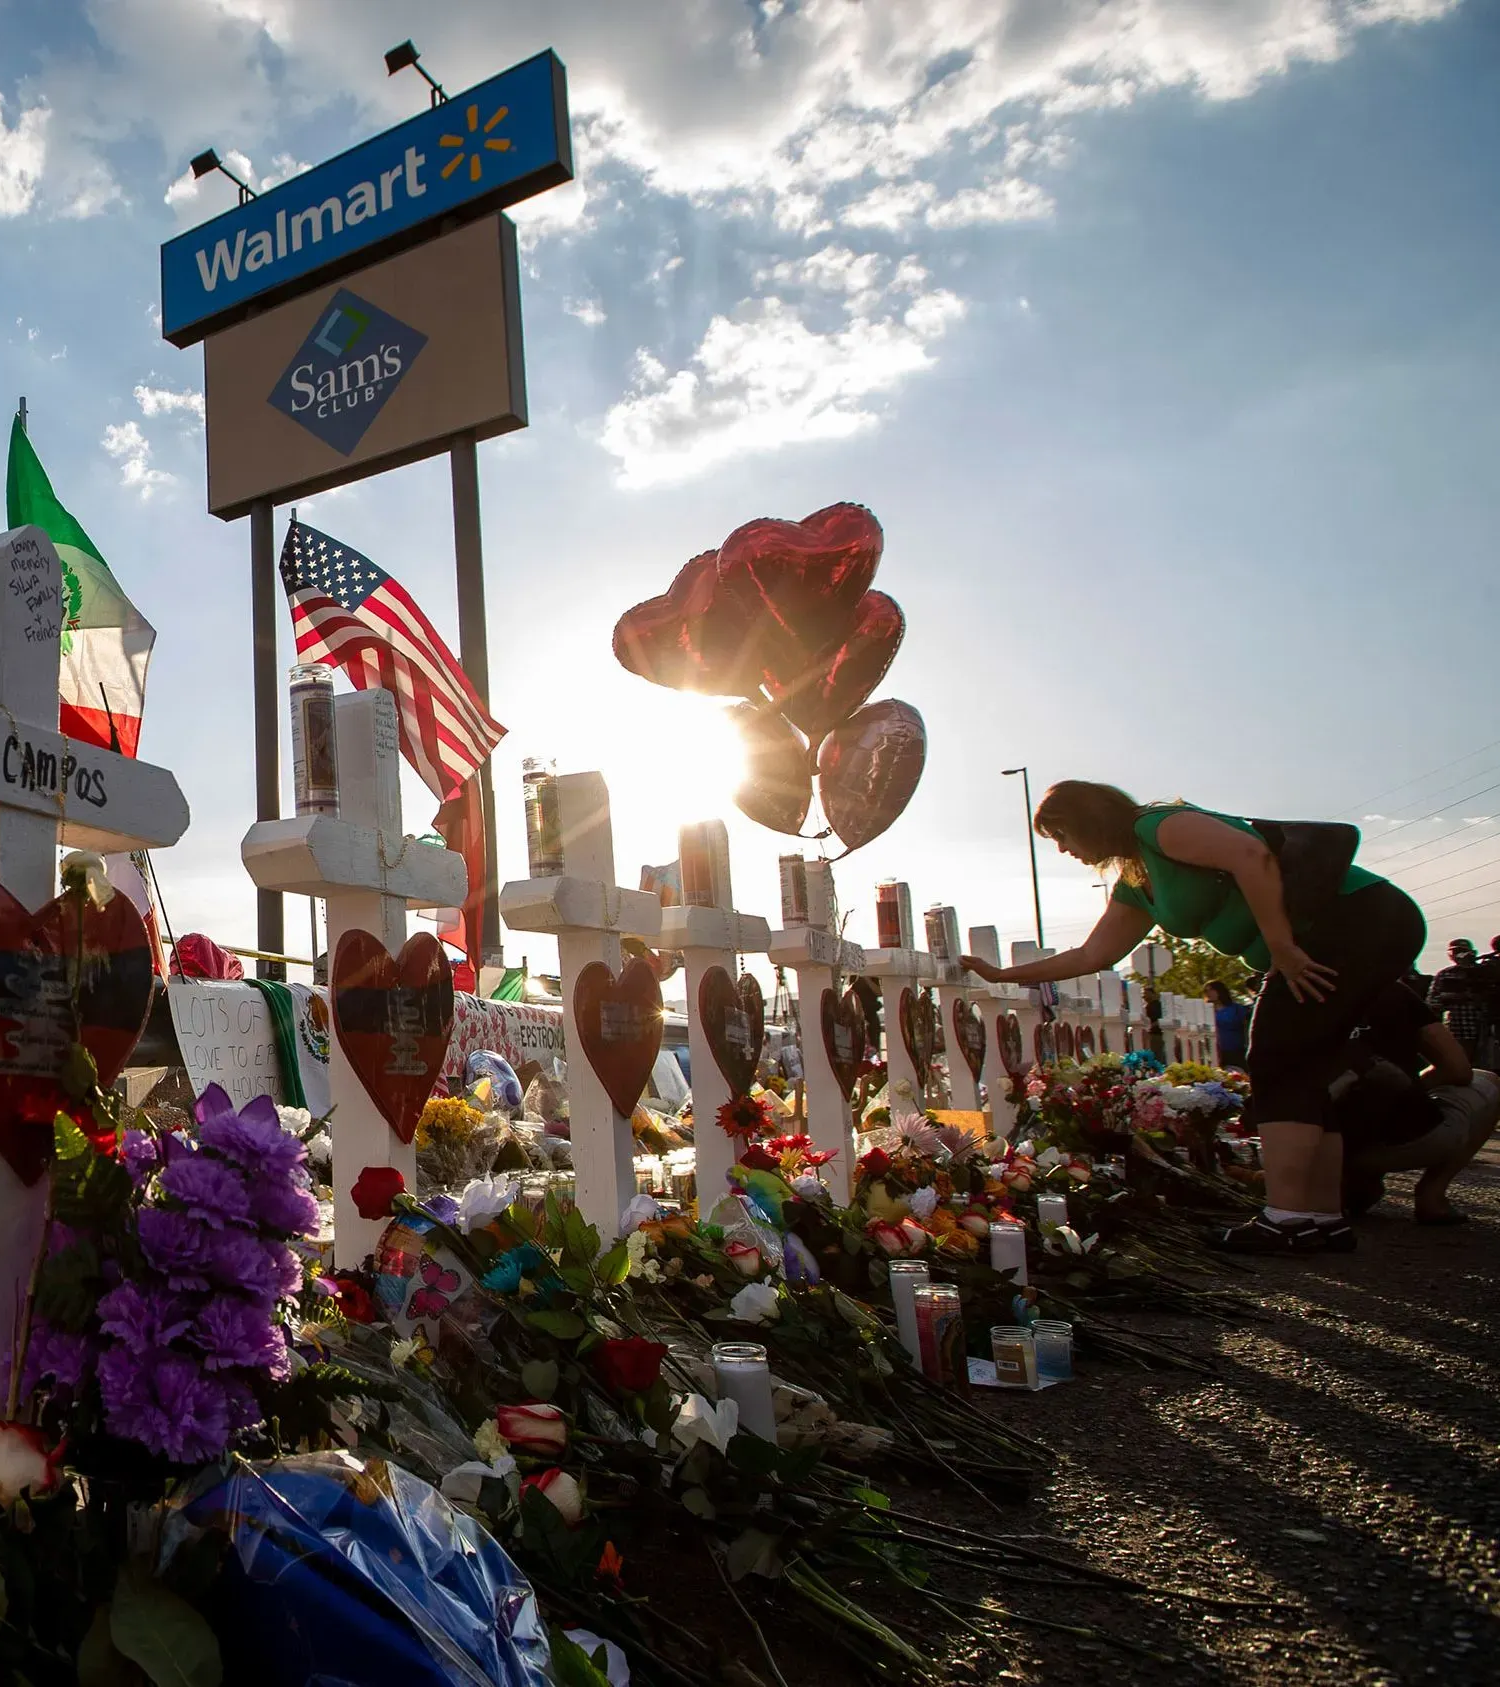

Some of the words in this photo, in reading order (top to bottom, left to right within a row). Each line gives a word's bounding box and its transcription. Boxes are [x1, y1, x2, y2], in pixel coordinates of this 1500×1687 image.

[195, 145, 427, 292] Walmart
[290, 343, 402, 413] Sam's
[317, 385, 376, 418] CLUB
[3, 735, 109, 808] CAMPOS
[175, 995, 230, 1038] LOTS
[237, 1000, 263, 1035] OF
[183, 1043, 224, 1071] LOVE
[227, 1045, 249, 1068] TO
